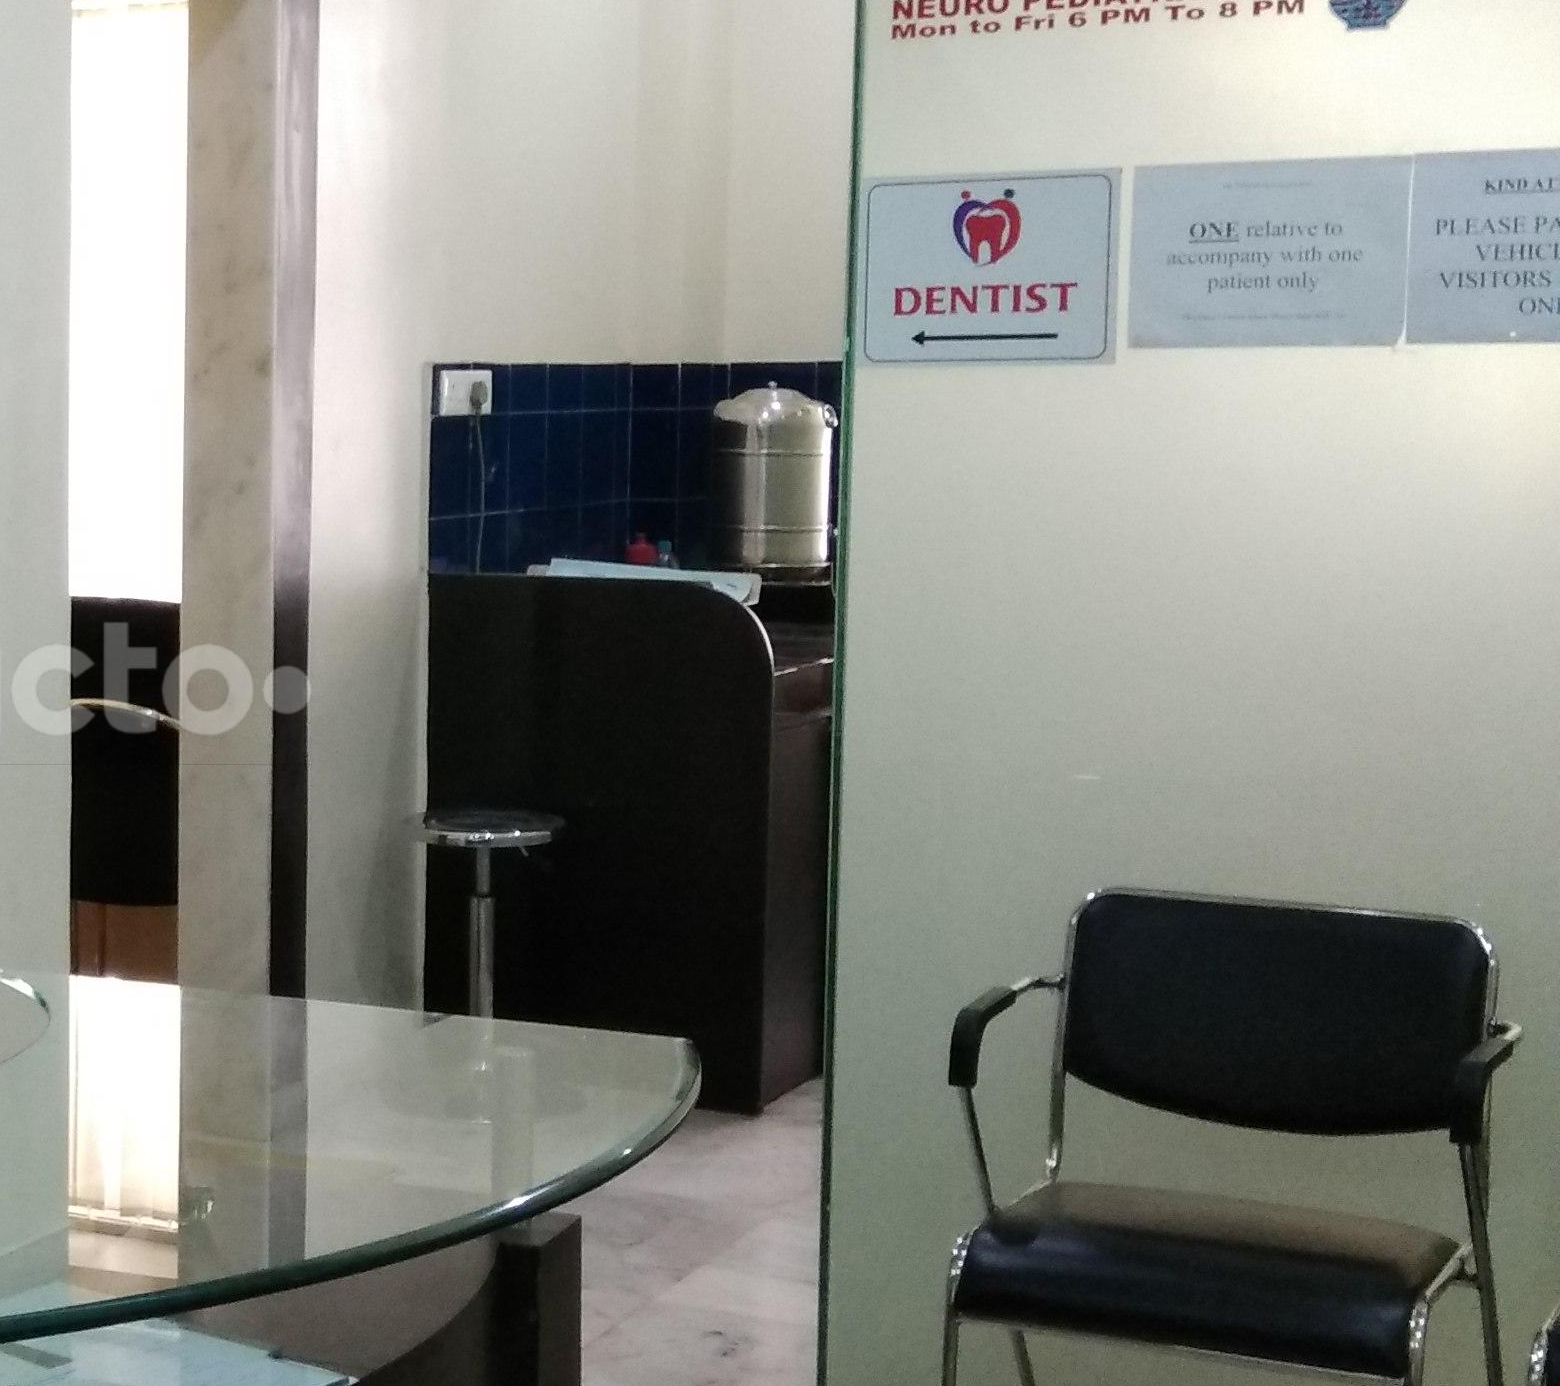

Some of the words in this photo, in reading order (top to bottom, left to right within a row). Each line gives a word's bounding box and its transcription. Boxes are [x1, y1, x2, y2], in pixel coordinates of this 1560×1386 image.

[892, 23, 956, 40] Mon
[970, 19, 1001, 34] to
[1014, 13, 1055, 32] Fri
[1068, 11, 1087, 28] 6
[1100, 7, 1151, 26] PM
[1165, 4, 1205, 21] To
[1219, 2, 1238, 18] 8
[1484, 177, 1528, 191] KIND
[1189, 221, 1239, 240] ONE
[1246, 220, 1319, 238] relative
[1325, 221, 1343, 237] to
[1436, 215, 1526, 236] PLEASE
[1166, 247, 1273, 268] accompany
[1280, 246, 1323, 262] with
[1328, 247, 1364, 262] one
[1207, 272, 1271, 294] patient
[1277, 271, 1319, 293] only
[1440, 269, 1553, 289] VISITORS
[893, 282, 1078, 316] DENTIST
